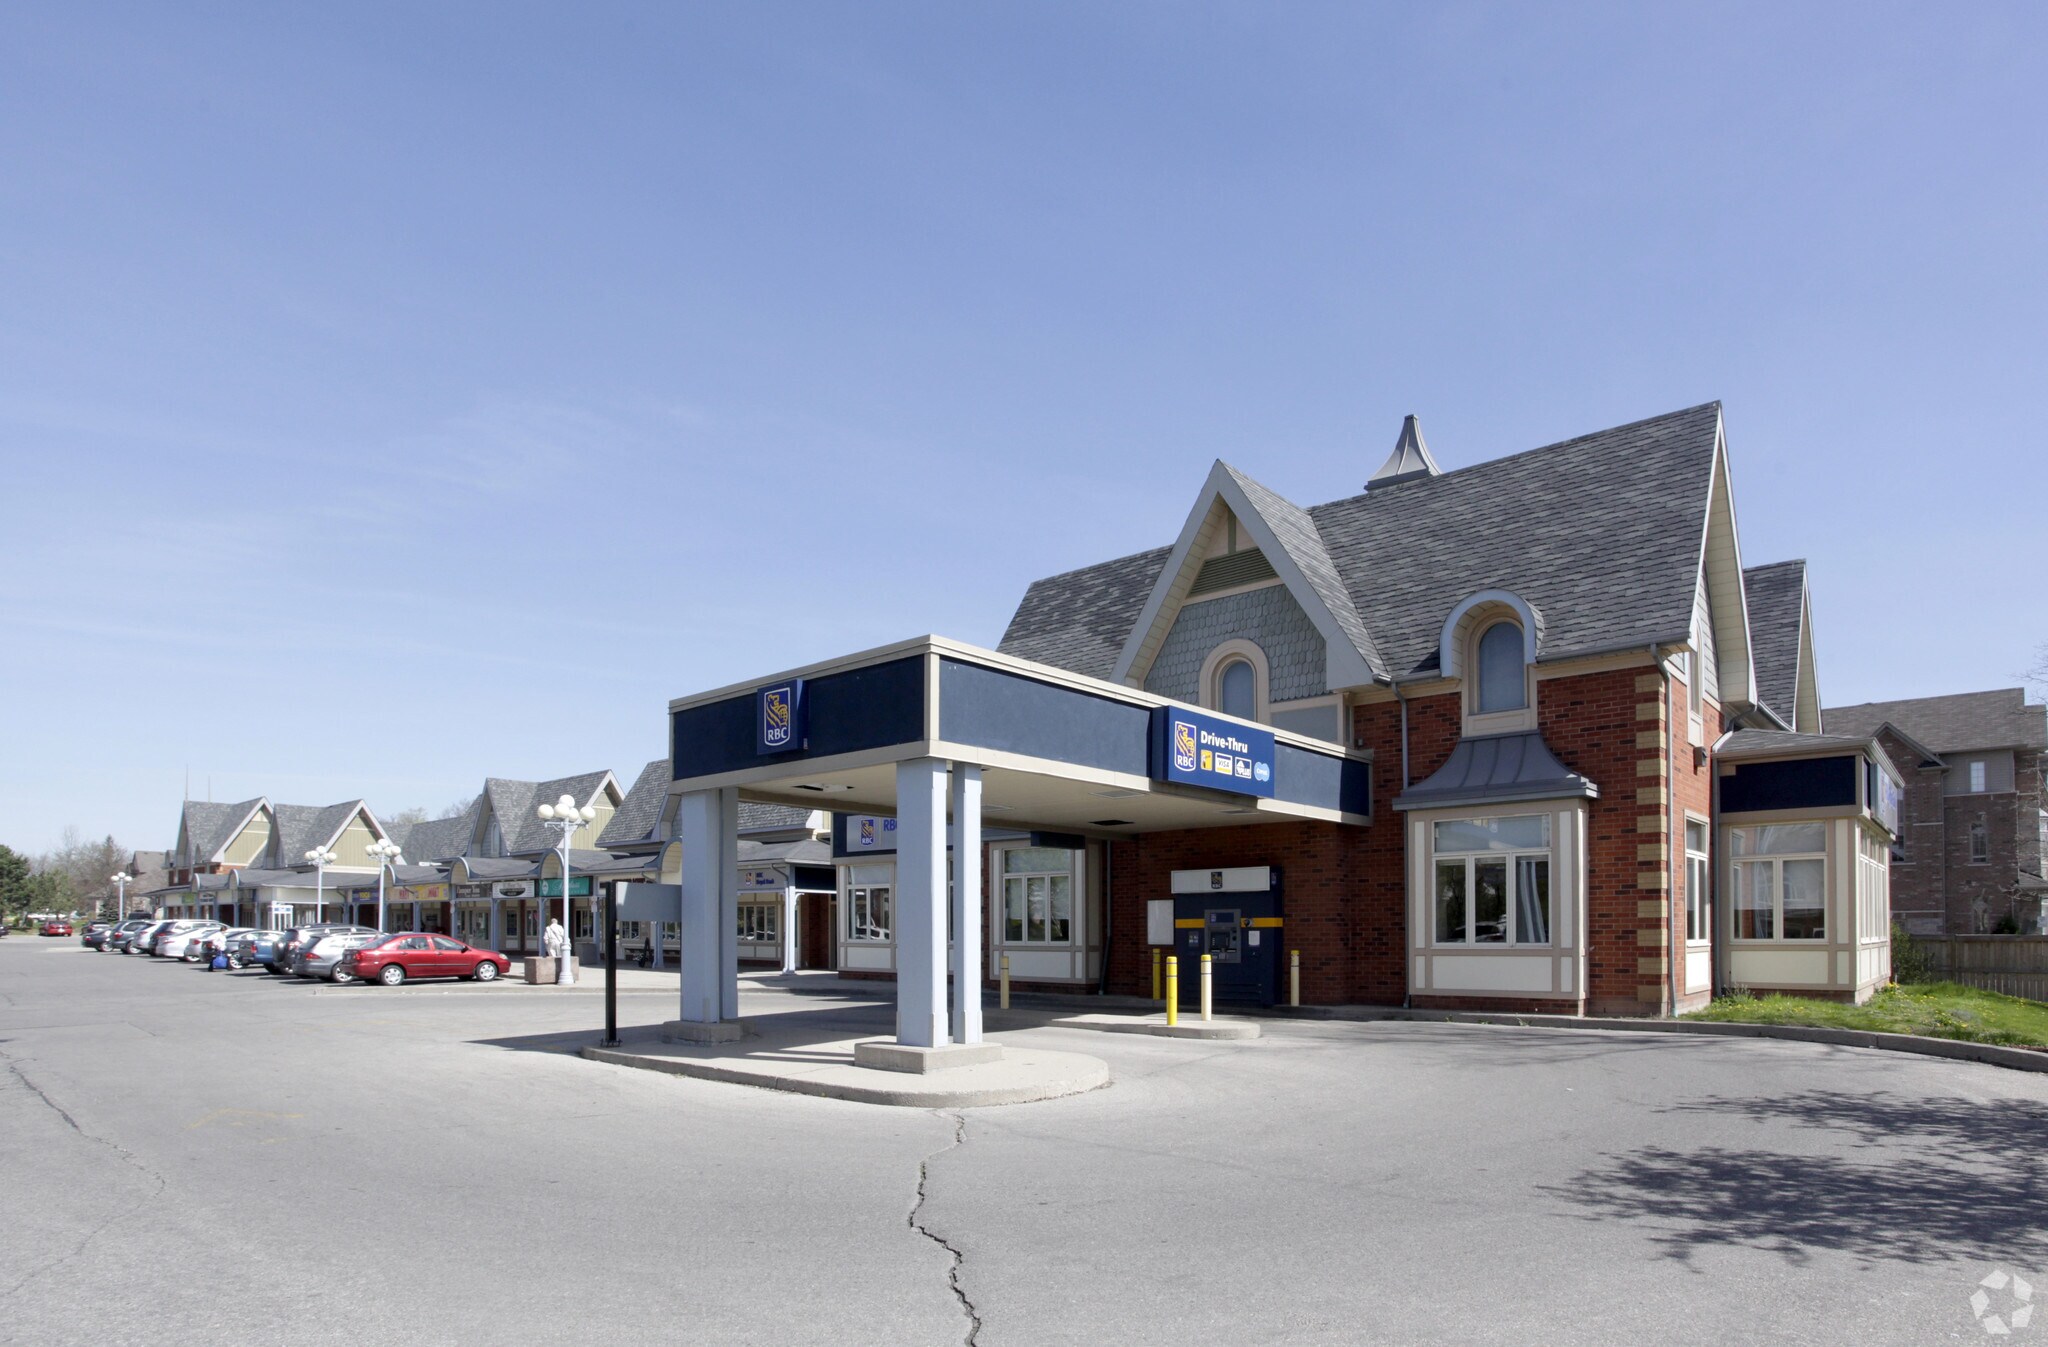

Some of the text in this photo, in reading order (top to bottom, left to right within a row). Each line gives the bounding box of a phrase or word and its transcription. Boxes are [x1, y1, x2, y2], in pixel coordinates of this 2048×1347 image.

[768, 727, 787, 741] RBC
[1201, 730, 1247, 753] Drive-Thru
[1177, 754, 1194, 768] RBC
[1218, 760, 1230, 768] VISA
[883, 818, 897, 832] RB
